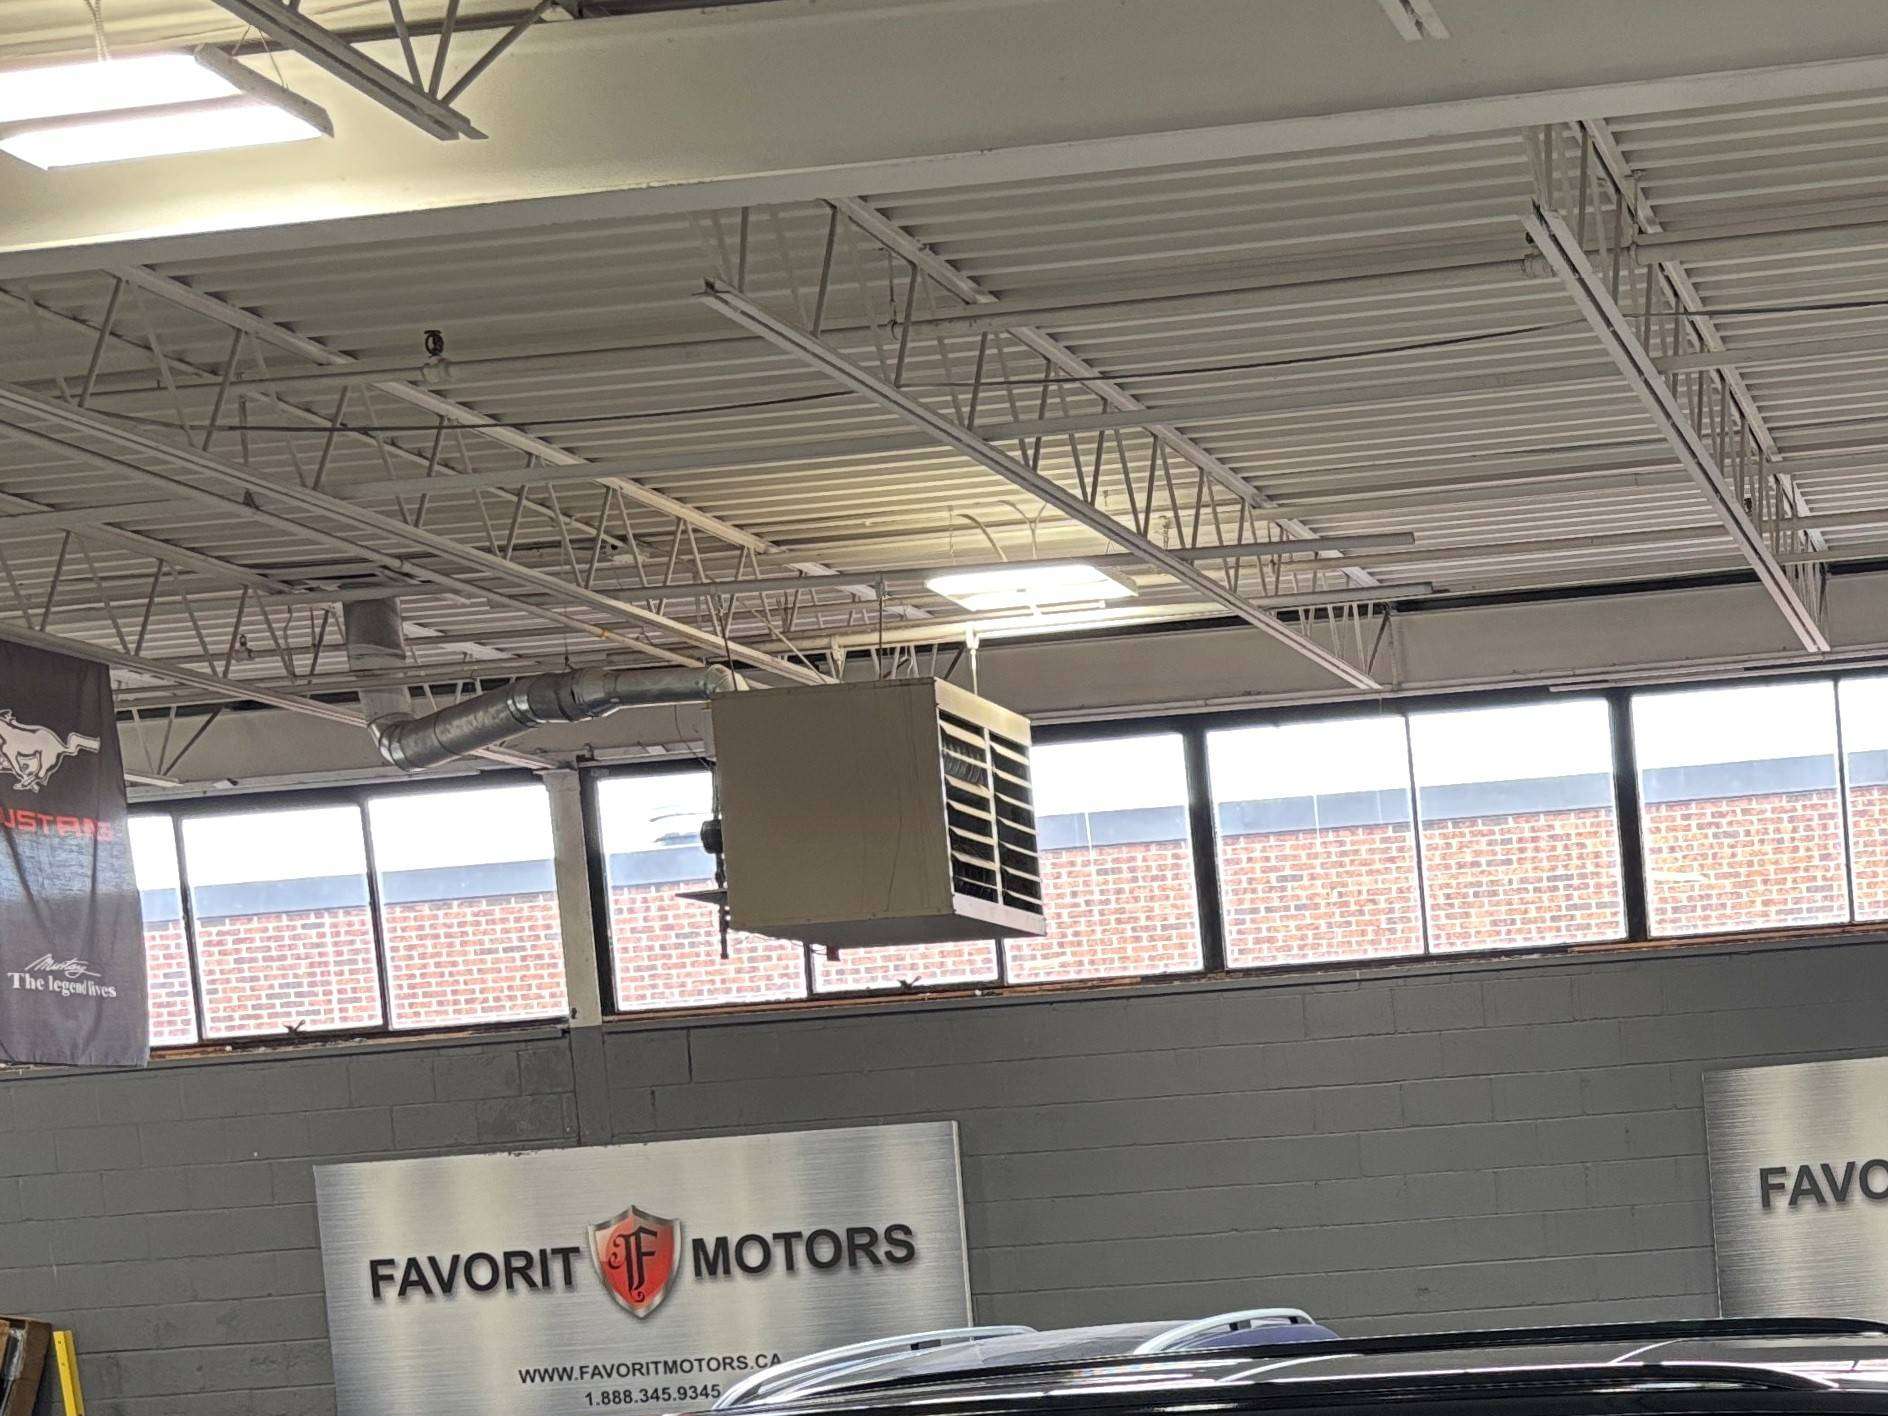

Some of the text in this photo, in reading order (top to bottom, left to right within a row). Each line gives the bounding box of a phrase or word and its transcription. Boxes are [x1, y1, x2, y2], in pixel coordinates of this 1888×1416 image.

[7, 972, 117, 998] The legend lives
[368, 1245, 581, 1300] FAVORIT
[692, 1222, 916, 1277] MOTORS
[518, 1352, 782, 1385] WWW.FAVORITMOTORS.CA
[584, 1383, 722, 1407] 1.888.345.9345
